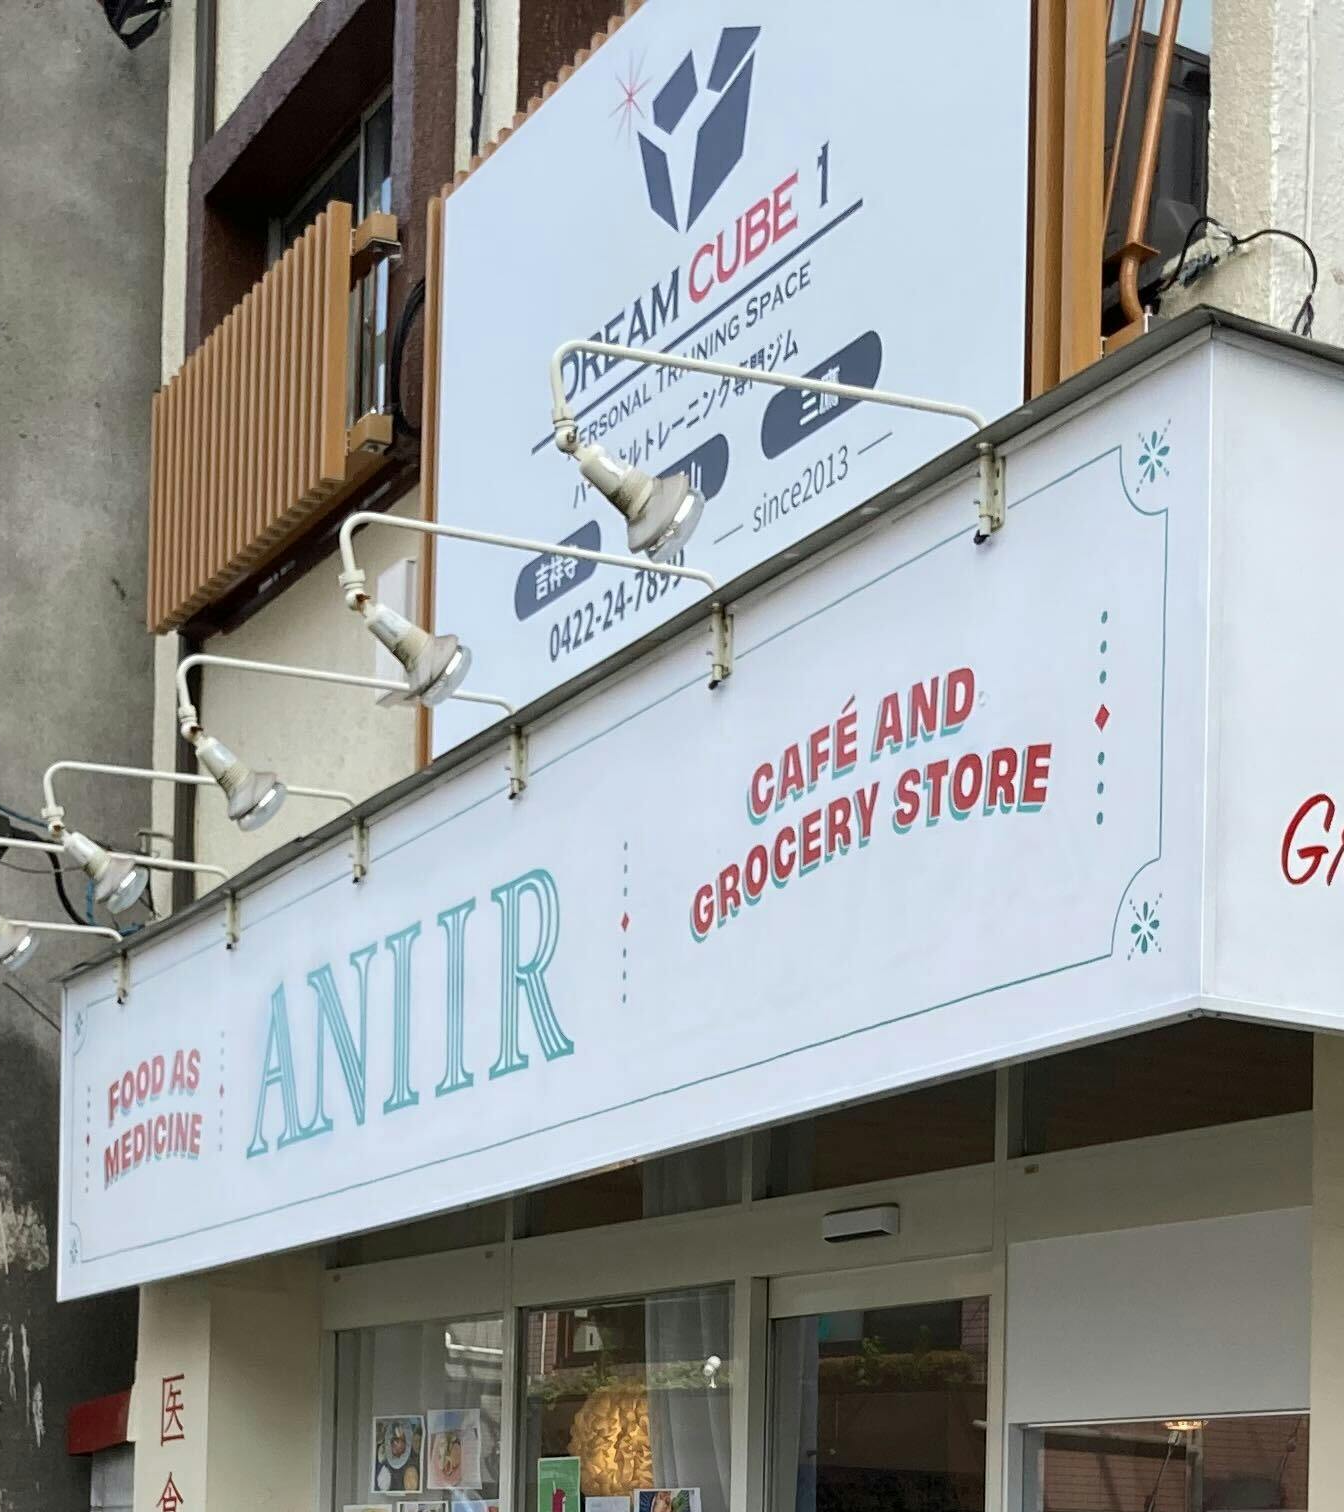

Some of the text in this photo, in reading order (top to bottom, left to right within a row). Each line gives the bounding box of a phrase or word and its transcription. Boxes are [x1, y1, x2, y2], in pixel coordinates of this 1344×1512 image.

[688, 170, 799, 303] CUBE
[816, 141, 830, 208] 1
[568, 382, 652, 457] ERSONAL
[745, 261, 811, 328] SPACE
[753, 445, 849, 532] since2013
[747, 667, 976, 825] CAFÉ AND
[689, 743, 1053, 943] GROCERY STORE
[107, 1048, 202, 1128] FOOD AS
[246, 869, 574, 1160] ANIIR
[103, 1112, 204, 1190] MEDICINE
